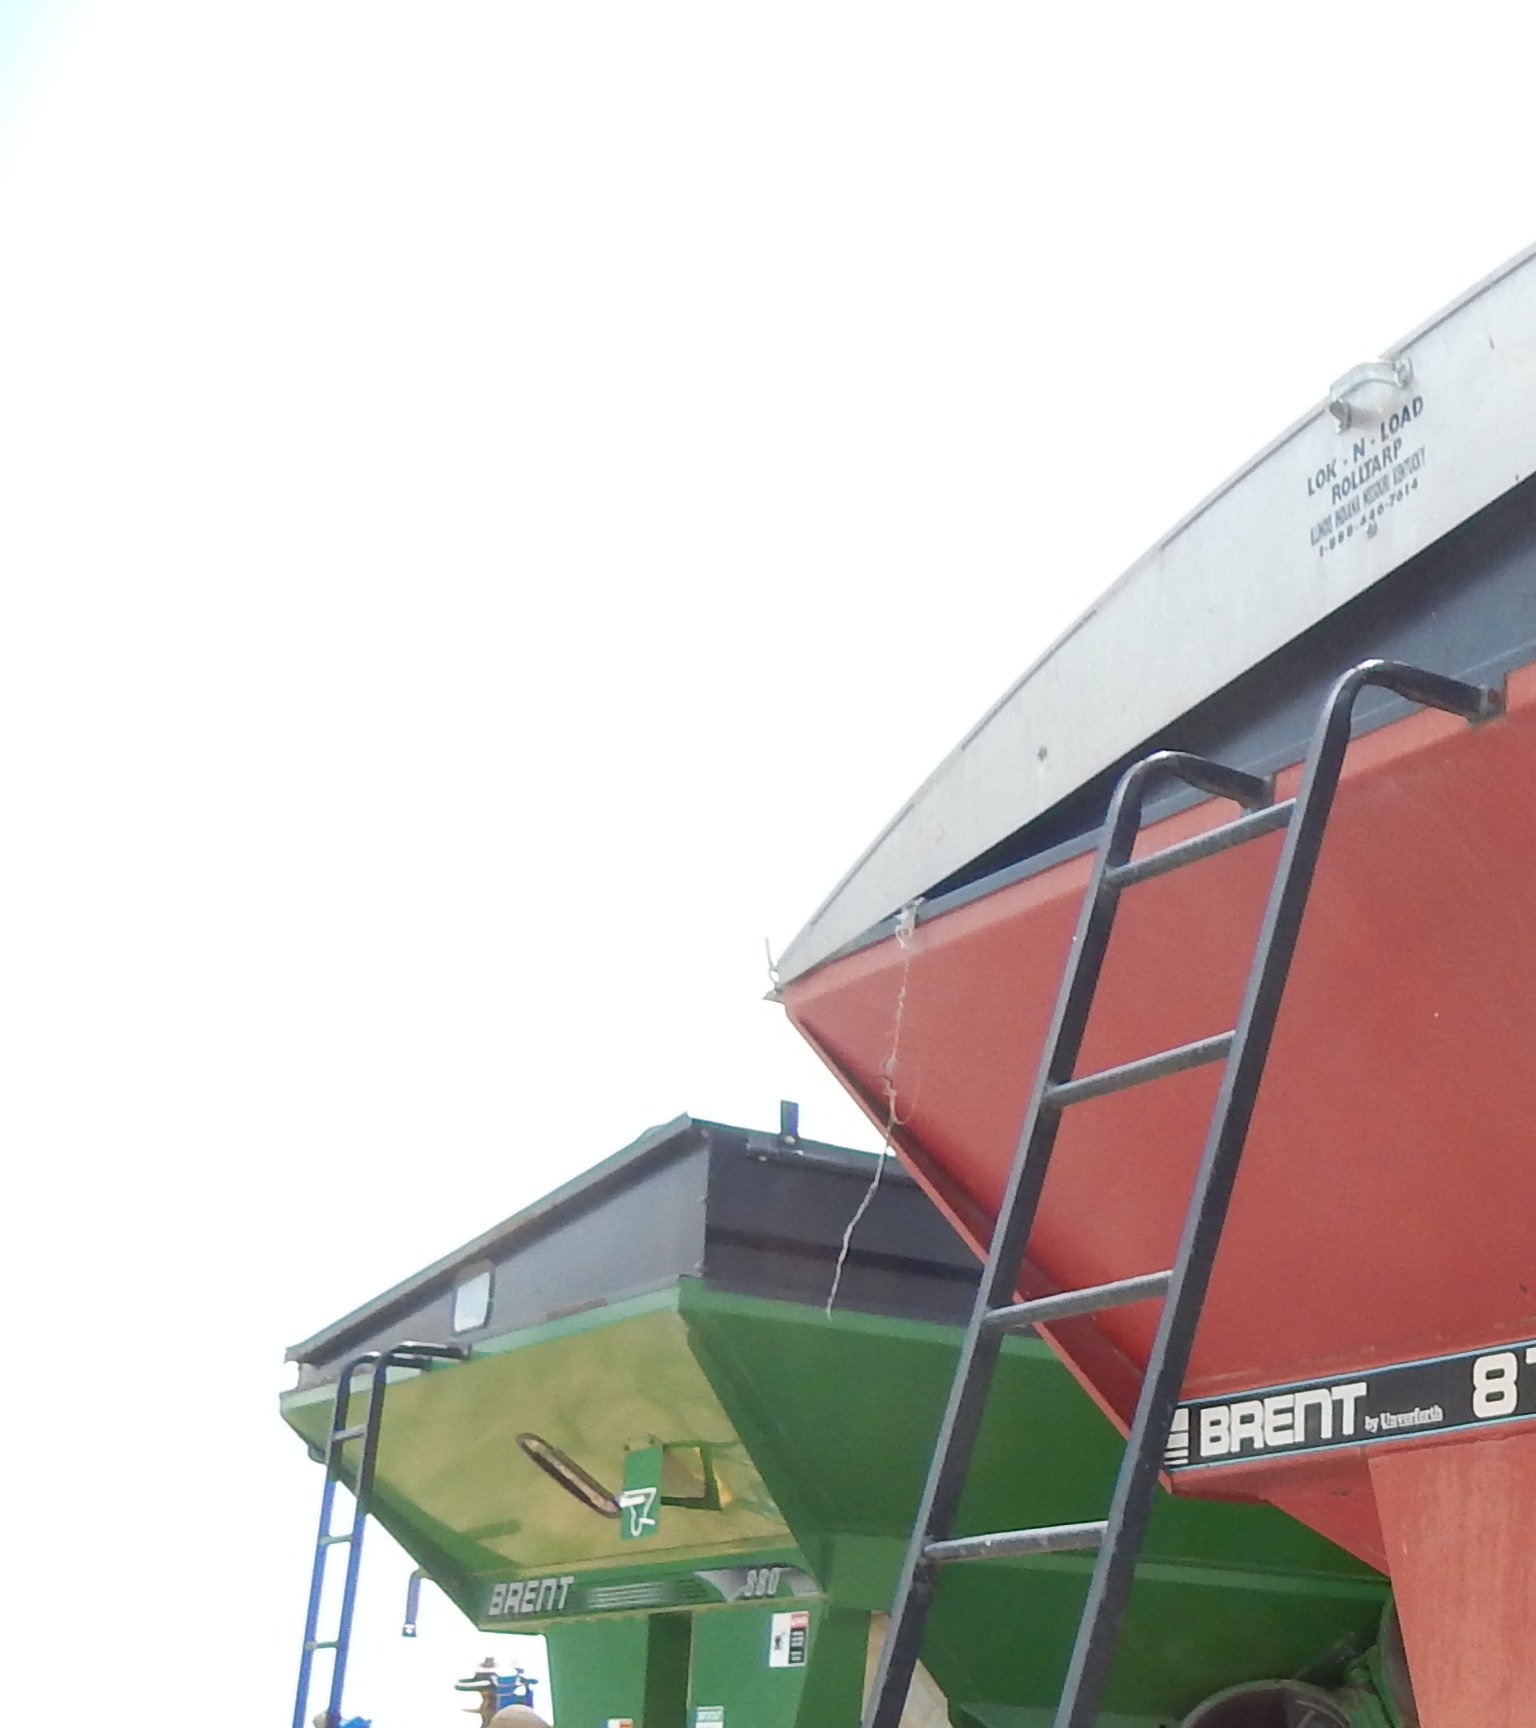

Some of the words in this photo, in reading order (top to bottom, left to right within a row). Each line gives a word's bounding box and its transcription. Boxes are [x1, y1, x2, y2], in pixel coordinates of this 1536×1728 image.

[1307, 458, 1337, 496] LOK
[1353, 438, 1366, 462] N
[1380, 396, 1424, 442] LOAD
[1332, 437, 1402, 505] ROLLTARP
[1199, 1382, 1367, 1458] BRENT
[1365, 1416, 1379, 1433] by
[488, 1576, 575, 1616] BRENT
